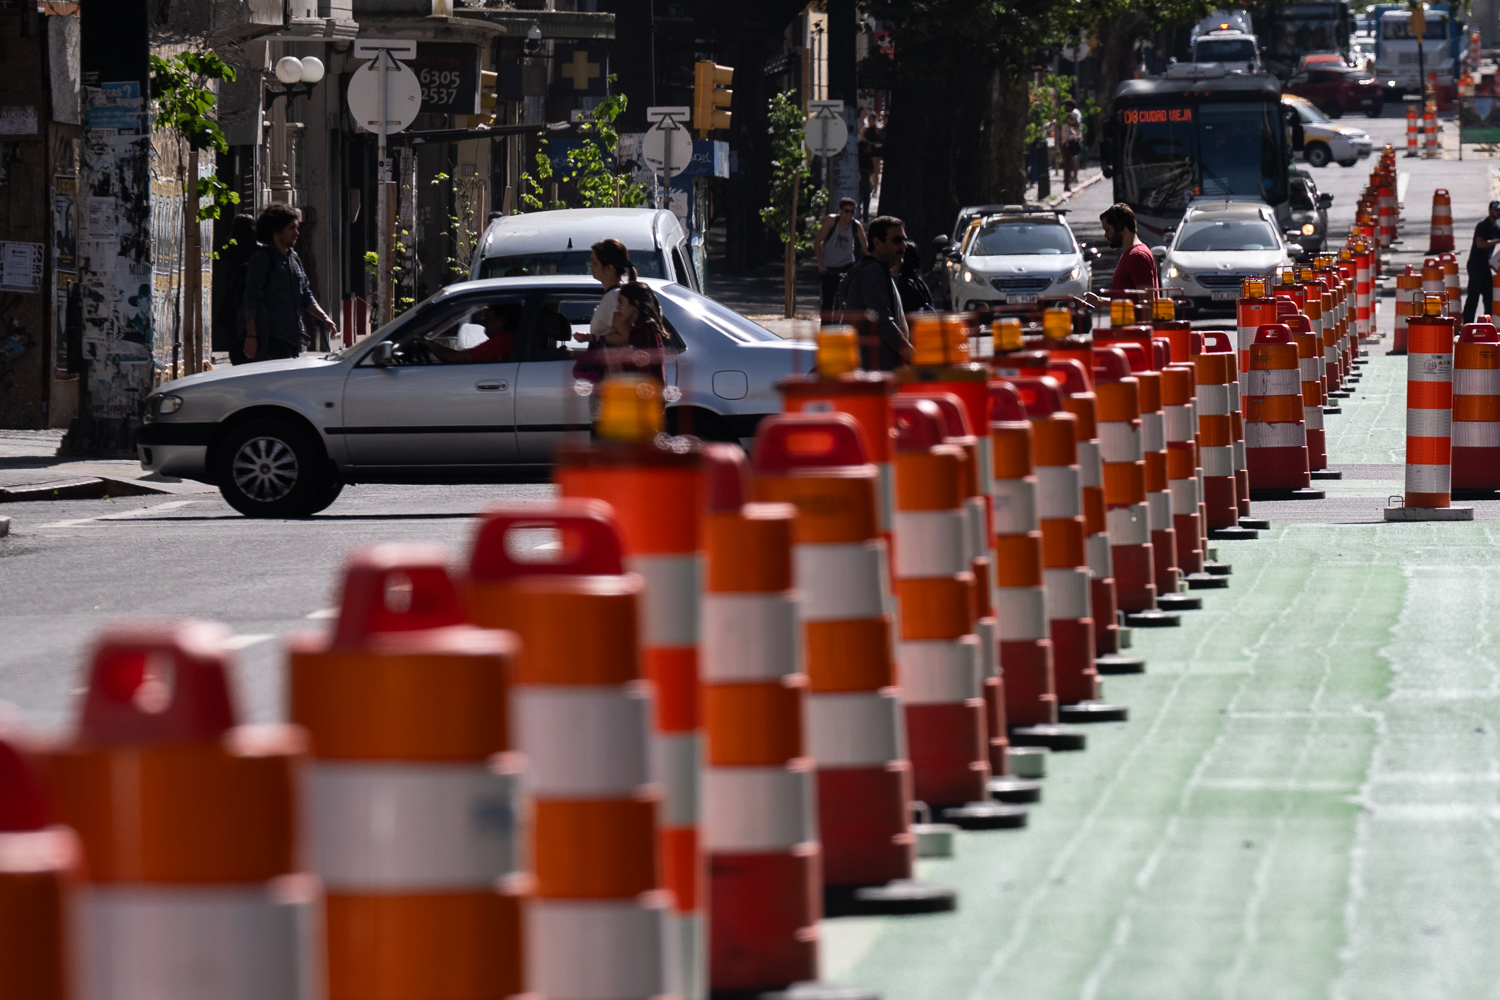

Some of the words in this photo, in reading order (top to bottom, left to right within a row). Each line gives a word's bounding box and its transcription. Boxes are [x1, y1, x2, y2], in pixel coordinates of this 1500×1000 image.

[420, 67, 460, 88] 6305
[421, 88, 457, 104] 2537
[1139, 109, 1167, 122] CIUDAD
